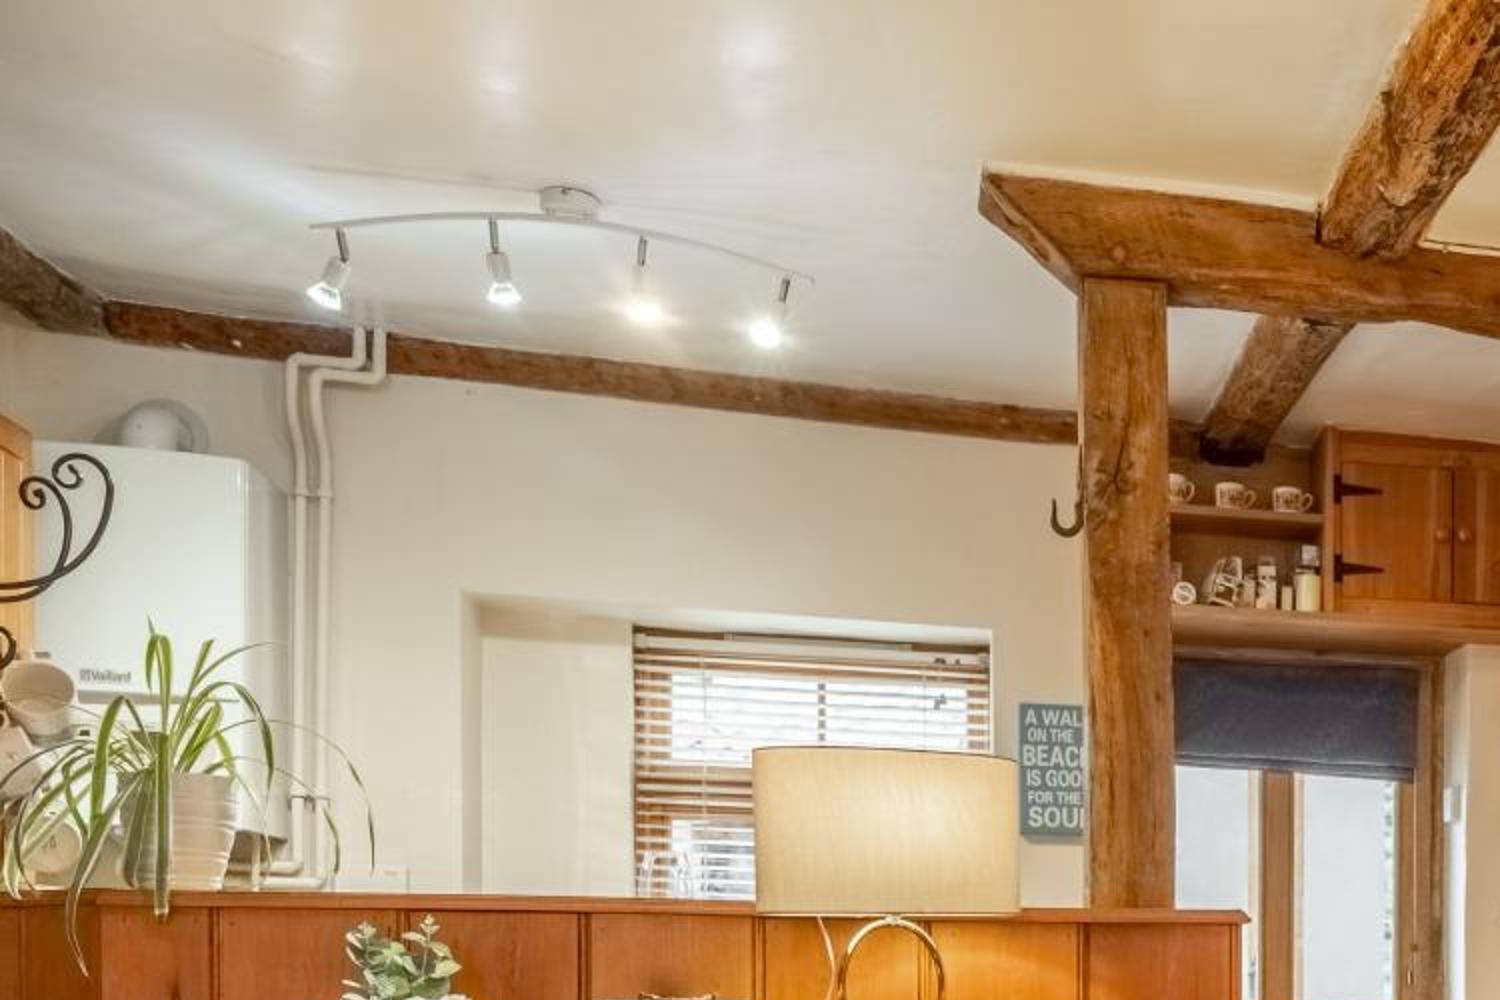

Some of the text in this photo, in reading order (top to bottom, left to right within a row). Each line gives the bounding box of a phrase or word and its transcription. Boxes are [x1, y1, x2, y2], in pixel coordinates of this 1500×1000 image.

[1025, 709, 1083, 727] A WAL
[1027, 727, 1074, 743] ON THE
[1026, 768, 1082, 788] IS GOO
[1027, 790, 1082, 806] FOR THE
